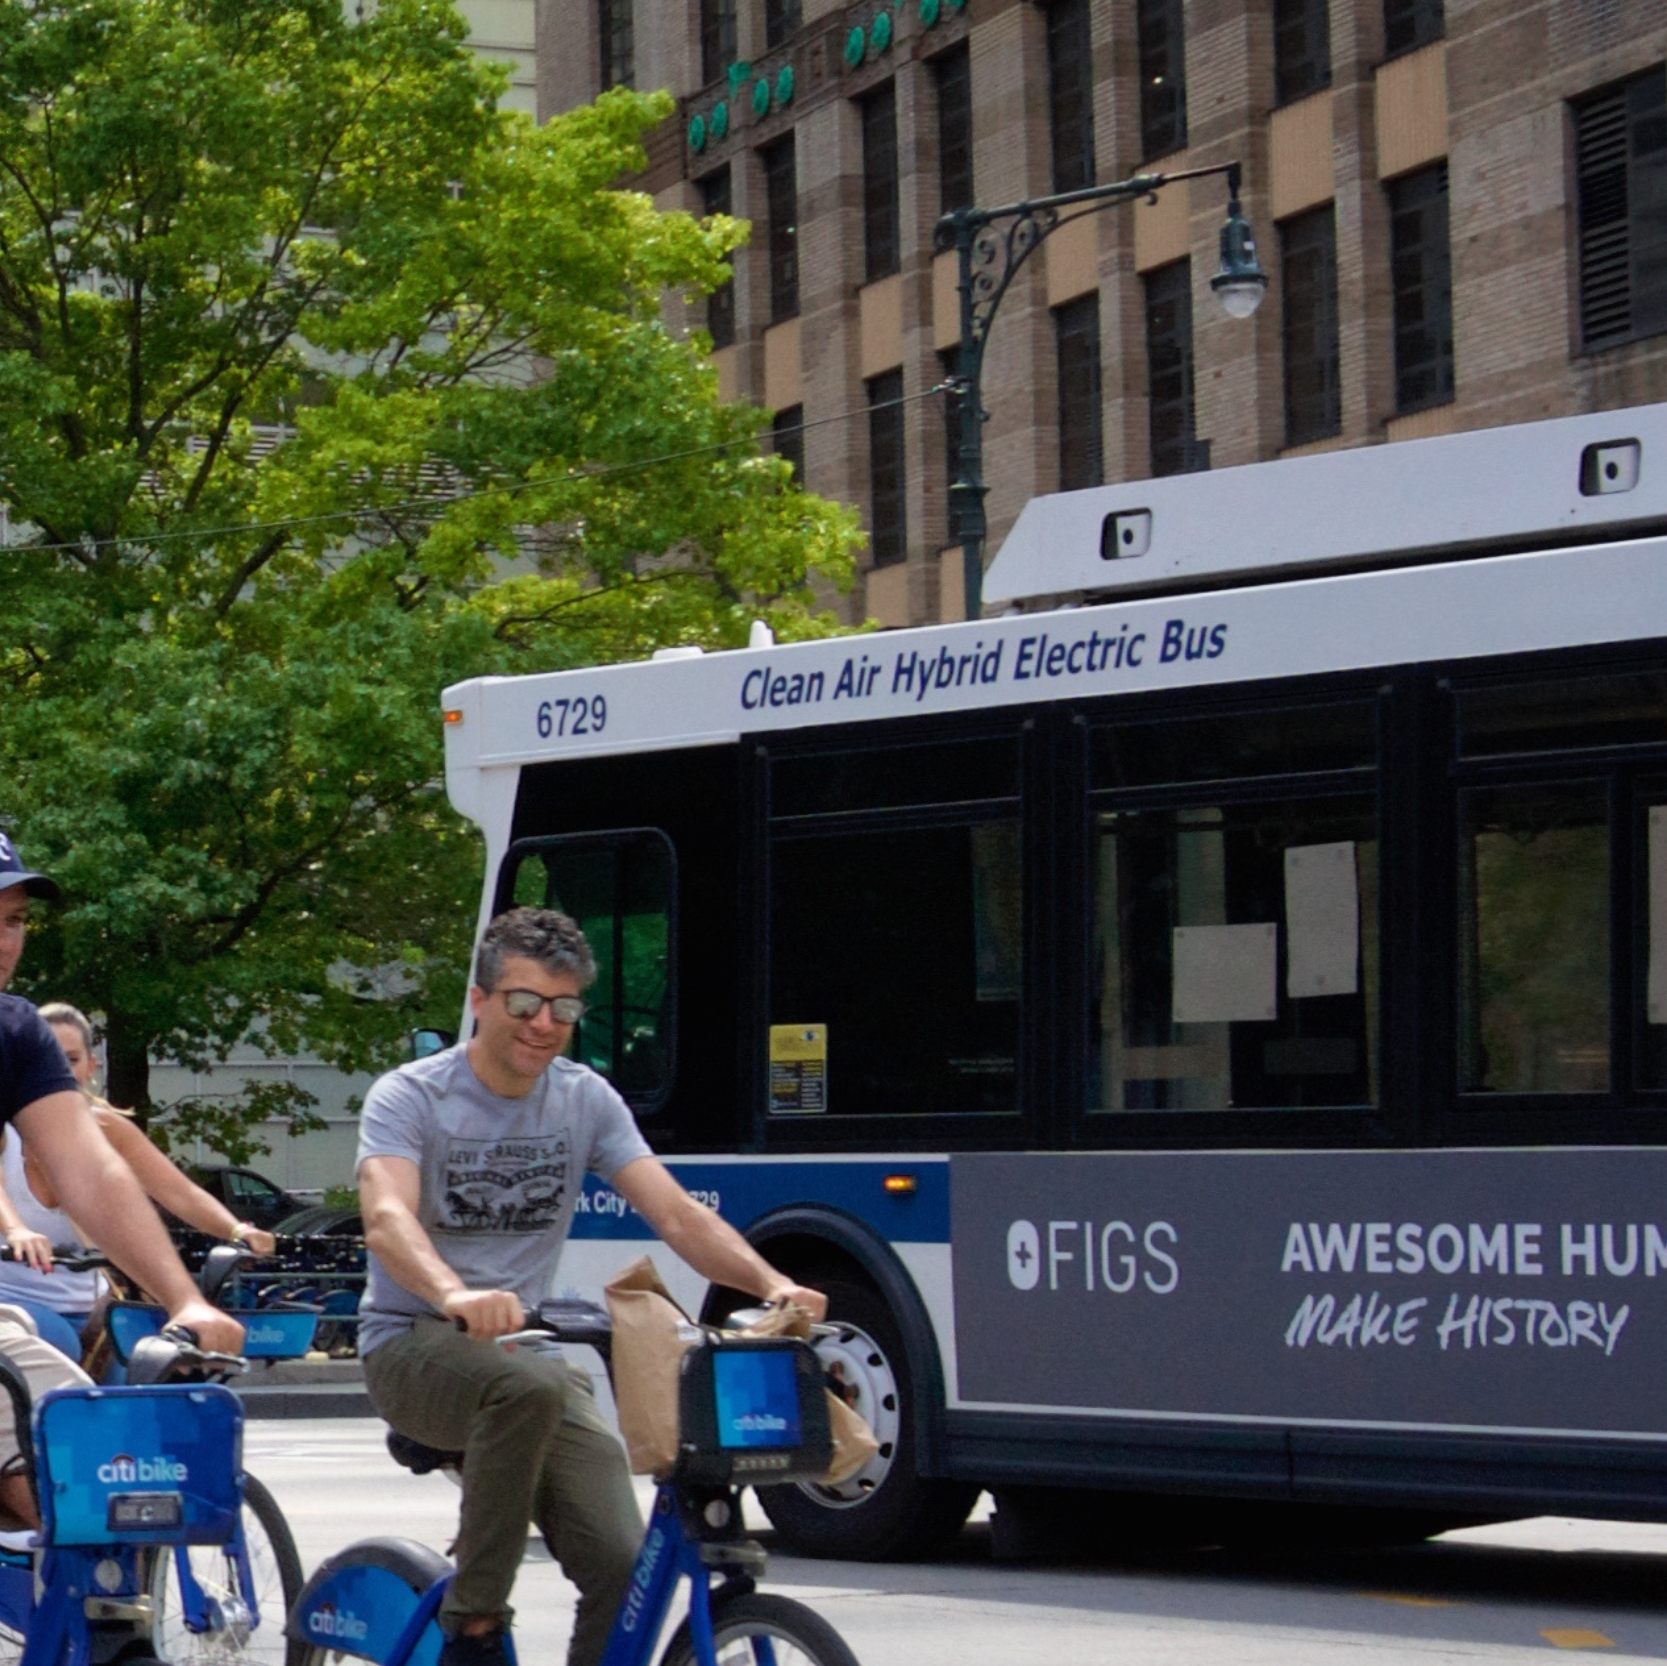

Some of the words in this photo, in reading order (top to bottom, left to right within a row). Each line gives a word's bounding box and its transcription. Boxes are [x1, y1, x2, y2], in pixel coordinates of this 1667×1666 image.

[740, 668, 823, 711] Clean
[833, 660, 882, 699] Air
[892, 637, 1000, 704] Hybrid
[1013, 631, 1146, 681] Electric
[1158, 619, 1227, 663] Bus
[536, 695, 607, 739] 6729
[484, 1144, 538, 1161] SRAUSS
[593, 1190, 628, 1218] City
[1048, 1219, 1179, 1294] FIGS
[1280, 1222, 1543, 1276] AWESOME
[1283, 1292, 1427, 1347] MAKE
[1436, 1292, 1629, 1356] HISTORY
[96, 1457, 136, 1484] citi
[137, 1454, 189, 1483] bike
